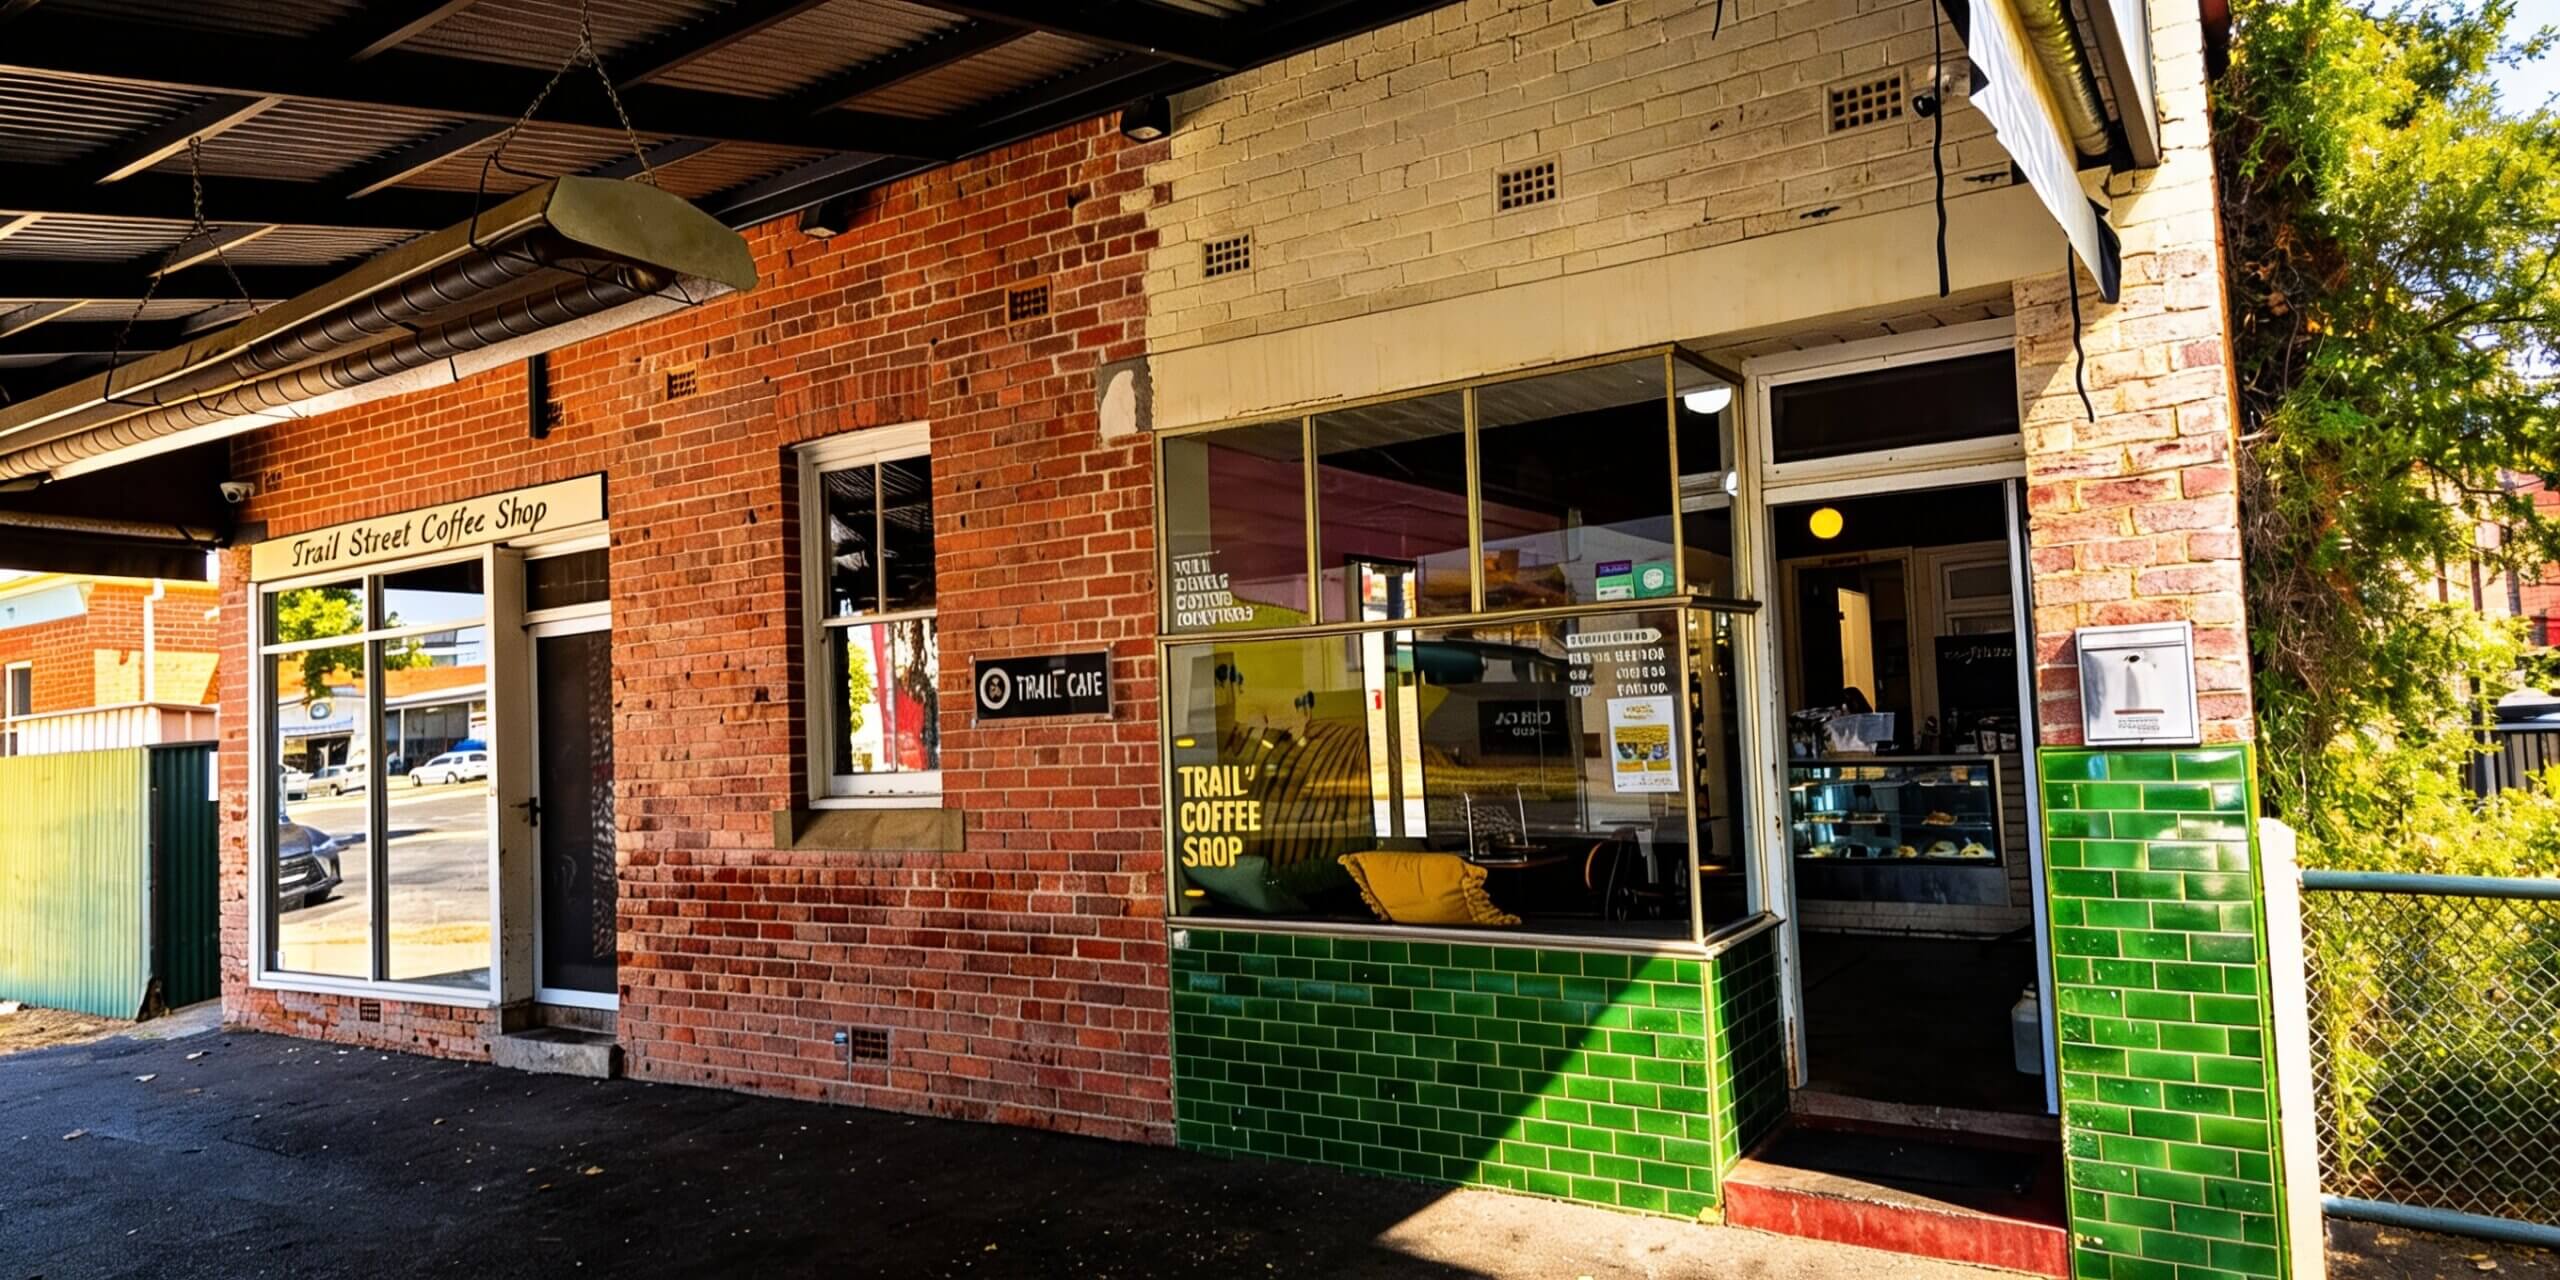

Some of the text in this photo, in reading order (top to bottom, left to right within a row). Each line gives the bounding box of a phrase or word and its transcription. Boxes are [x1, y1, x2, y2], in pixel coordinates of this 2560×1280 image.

[291, 496, 548, 568] Trail Street Coffee Shop
[1180, 800, 1262, 833] COFFEE
